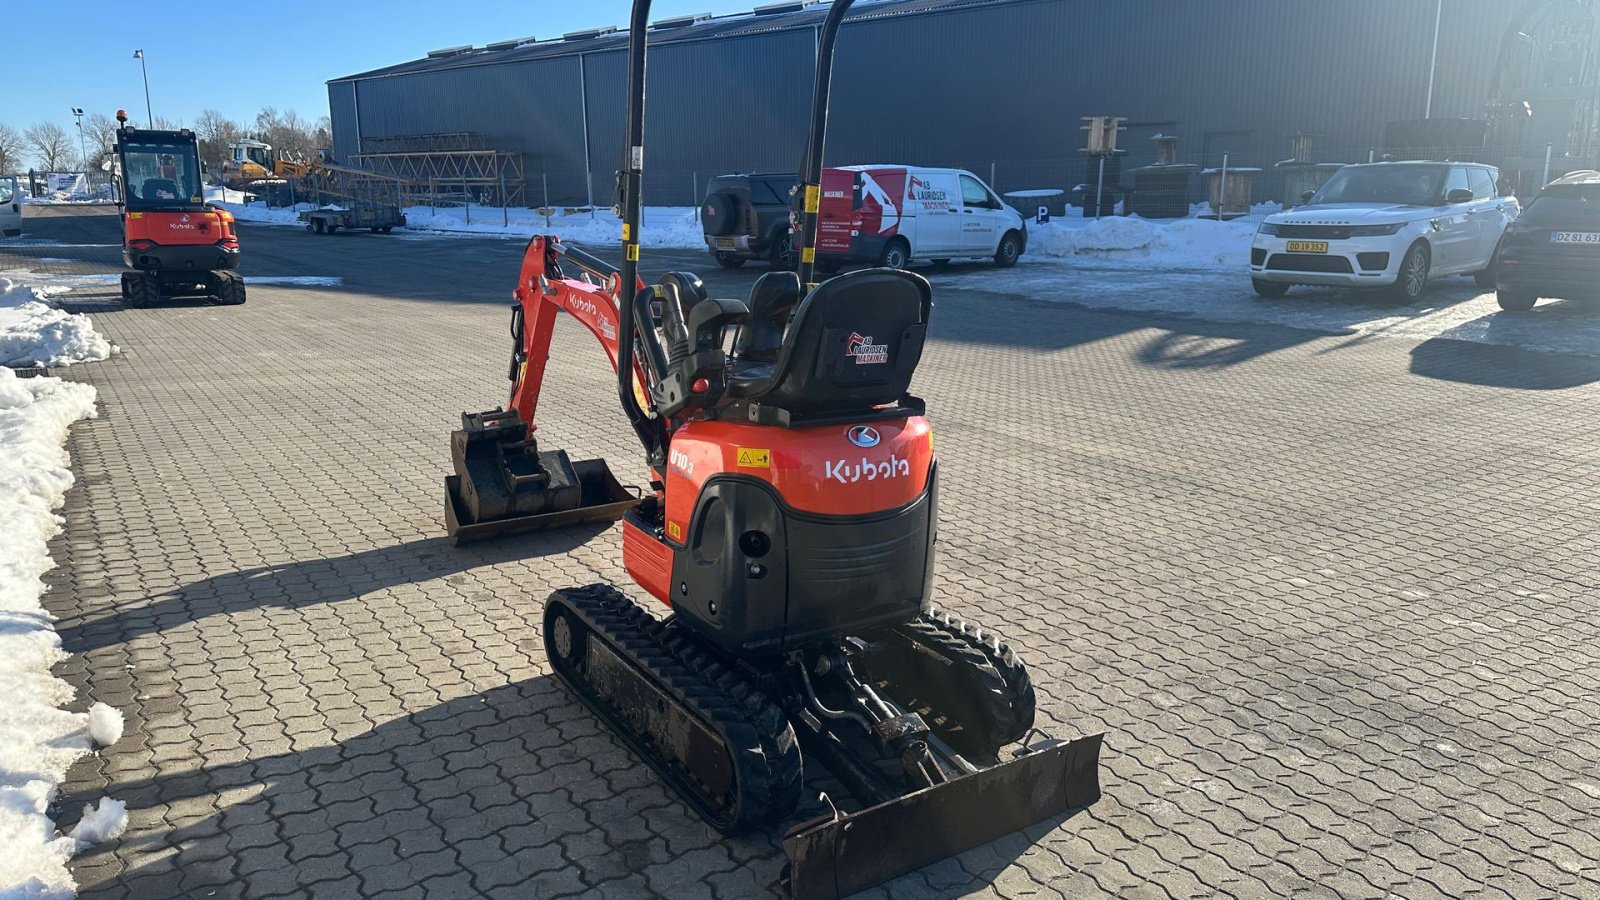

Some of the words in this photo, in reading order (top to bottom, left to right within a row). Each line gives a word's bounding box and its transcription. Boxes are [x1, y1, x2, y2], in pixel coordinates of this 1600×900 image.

[923, 181, 931, 190] AB
[917, 191, 947, 200] LAURIDSEN
[1038, 206, 1049, 221] P
[569, 293, 597, 315] Kubota
[854, 345, 888, 354] LAURIDSEN
[856, 354, 888, 364] MASKINER
[670, 449, 694, 474] U10-3
[825, 454, 910, 484] Kubota
